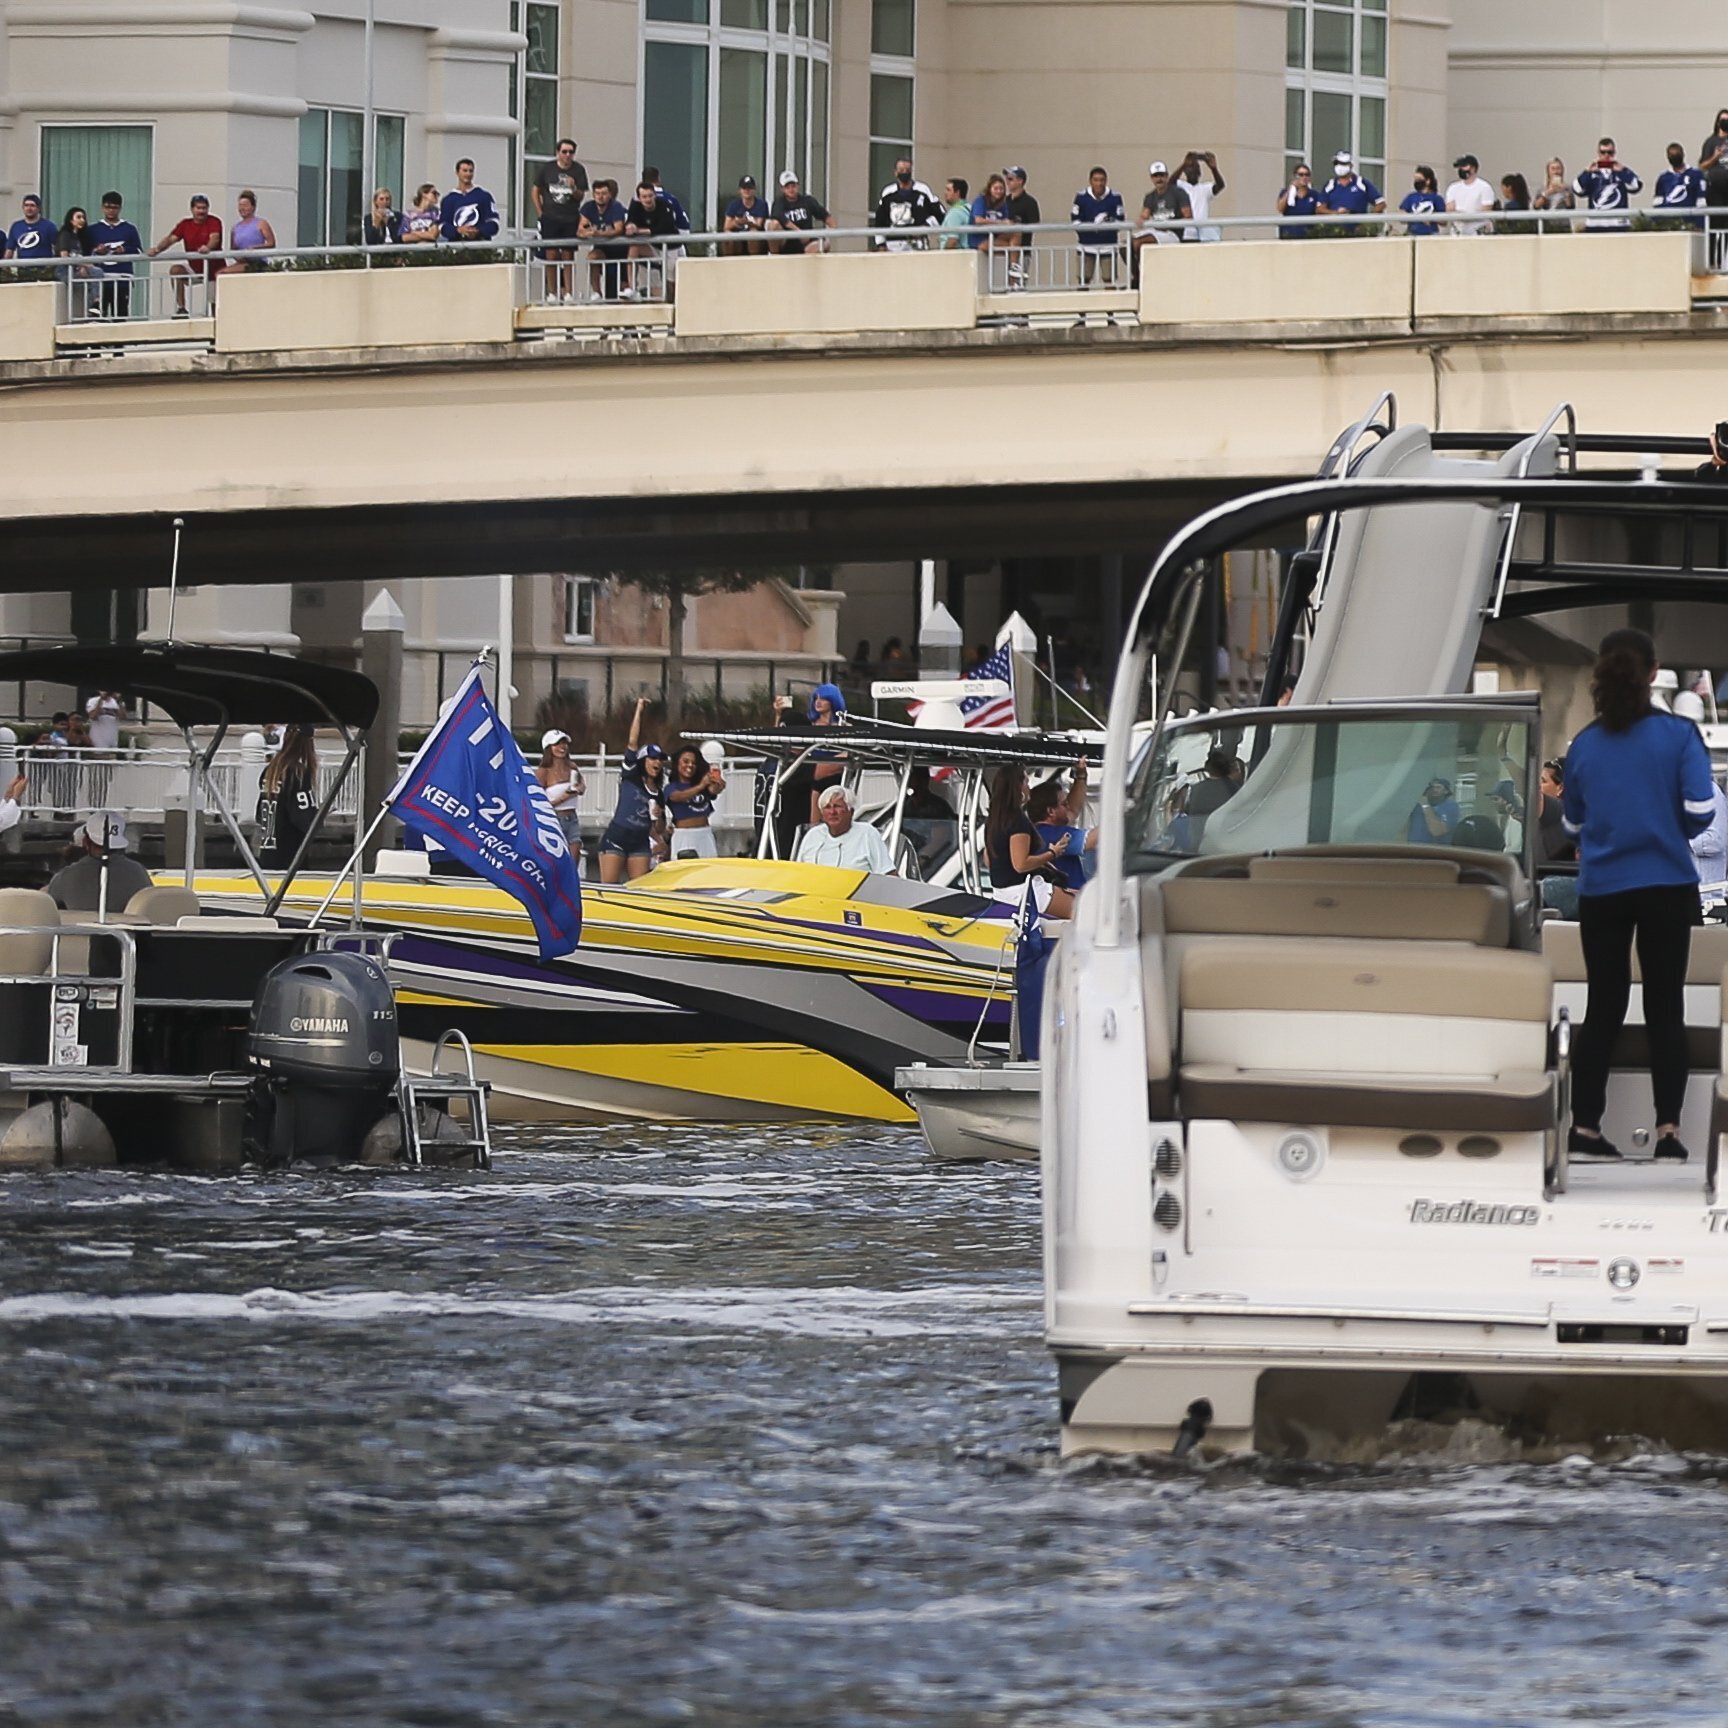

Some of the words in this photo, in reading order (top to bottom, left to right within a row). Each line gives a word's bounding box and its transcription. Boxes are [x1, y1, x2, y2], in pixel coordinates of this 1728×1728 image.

[880, 685, 915, 693] GARMIN
[297, 790, 316, 809] 91
[420, 784, 470, 819] KEEP
[373, 1010, 394, 1020] 115
[302, 1018, 349, 1033] YAMAHA
[1410, 1199, 1540, 1225] Radiance
